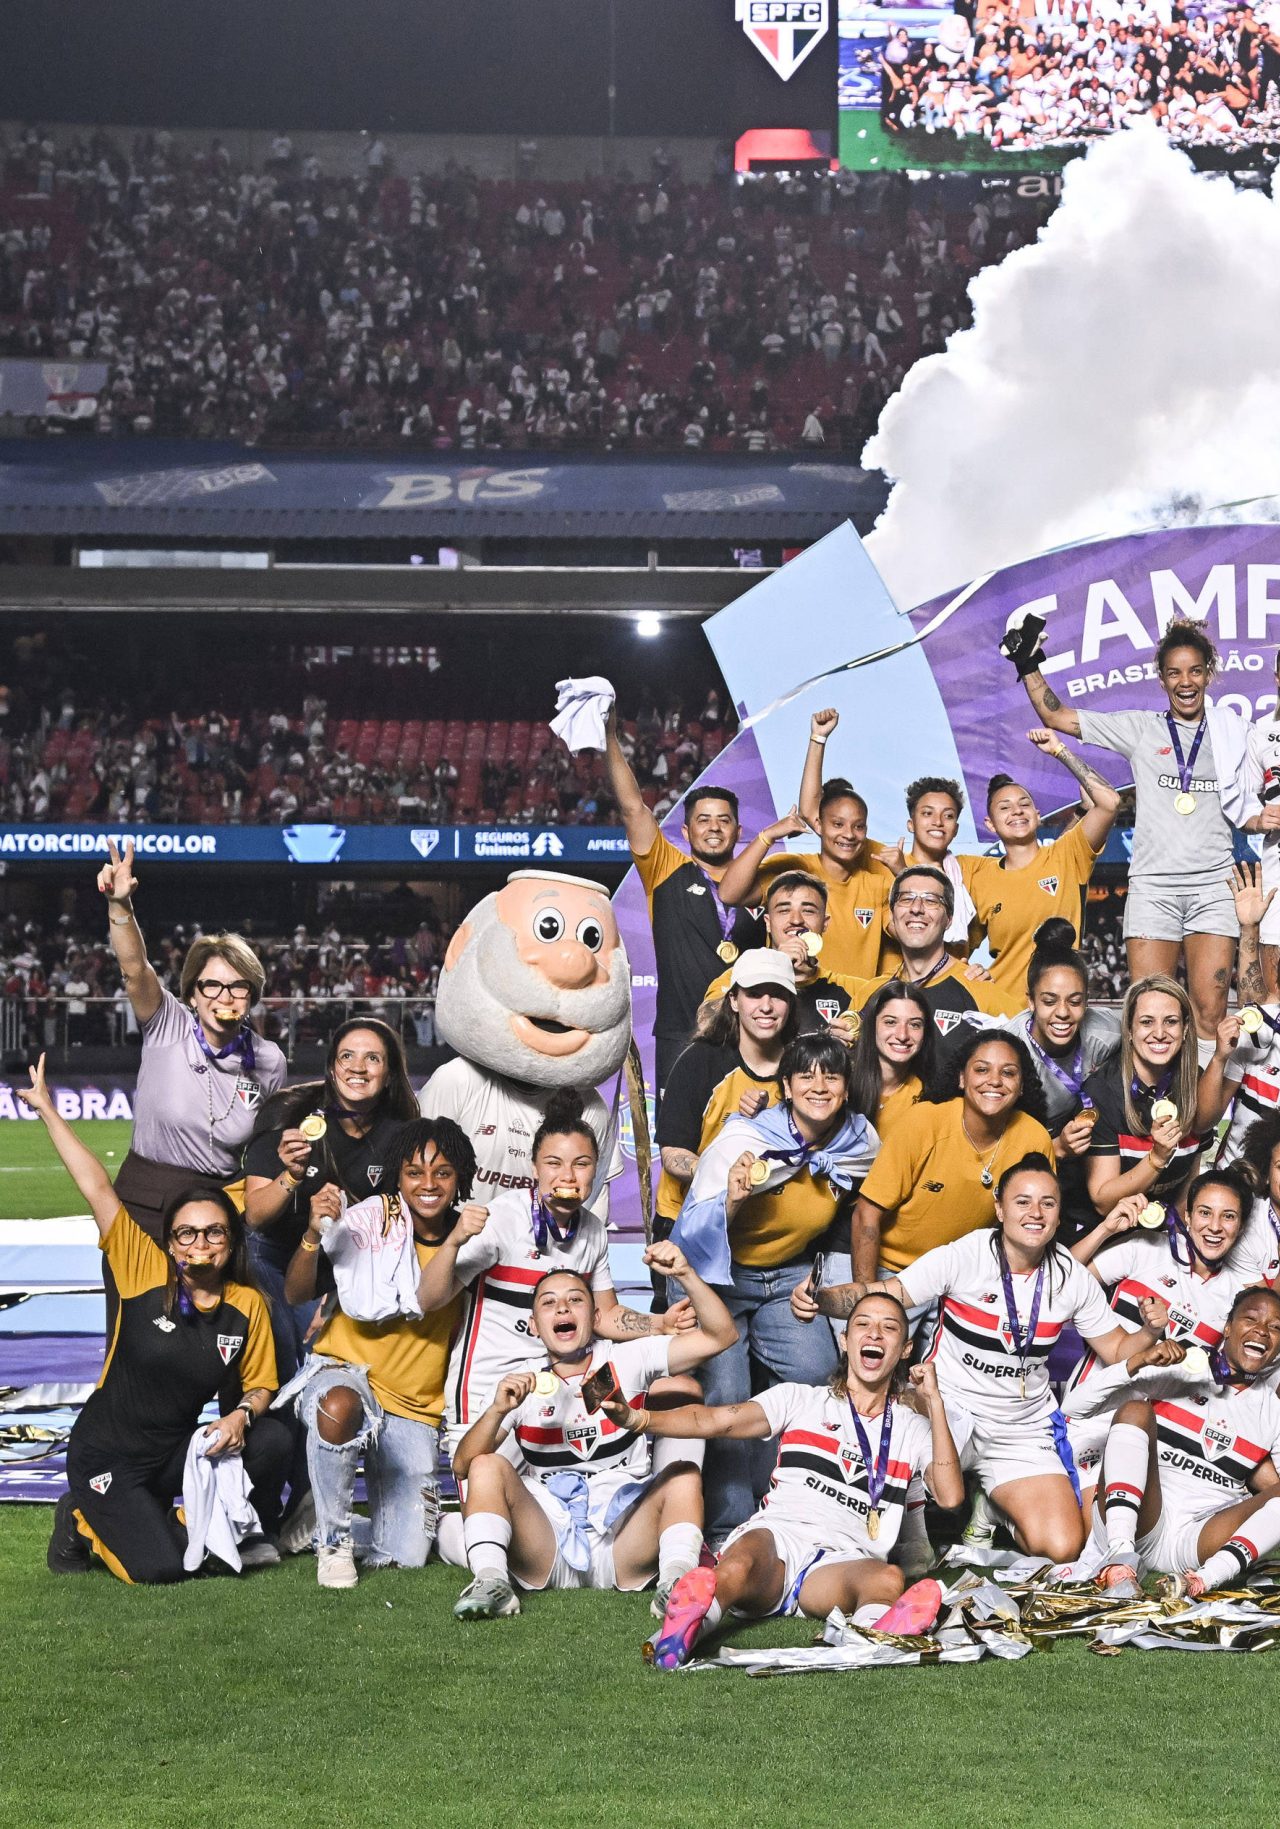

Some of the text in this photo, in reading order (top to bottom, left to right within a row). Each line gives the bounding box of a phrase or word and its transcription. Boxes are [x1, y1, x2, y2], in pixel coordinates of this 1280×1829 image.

[752, 3, 821, 22] SPFC
[0, 834, 217, 854] ATORCIDATRICOLOR
[474, 832, 530, 843] SEGUROS
[474, 843, 530, 857] Unimed
[585, 838, 629, 851] APRESE
[818, 1000, 838, 1009] SPFC
[935, 1010, 961, 1021] SPFC
[236, 1082, 260, 1093] SPFC
[476, 1166, 540, 1190] UPERB
[1170, 1310, 1195, 1330] SPFC
[219, 1337, 242, 1345] SPFC
[568, 1428, 598, 1440] SPFC
[1205, 1427, 1232, 1446] SPFC
